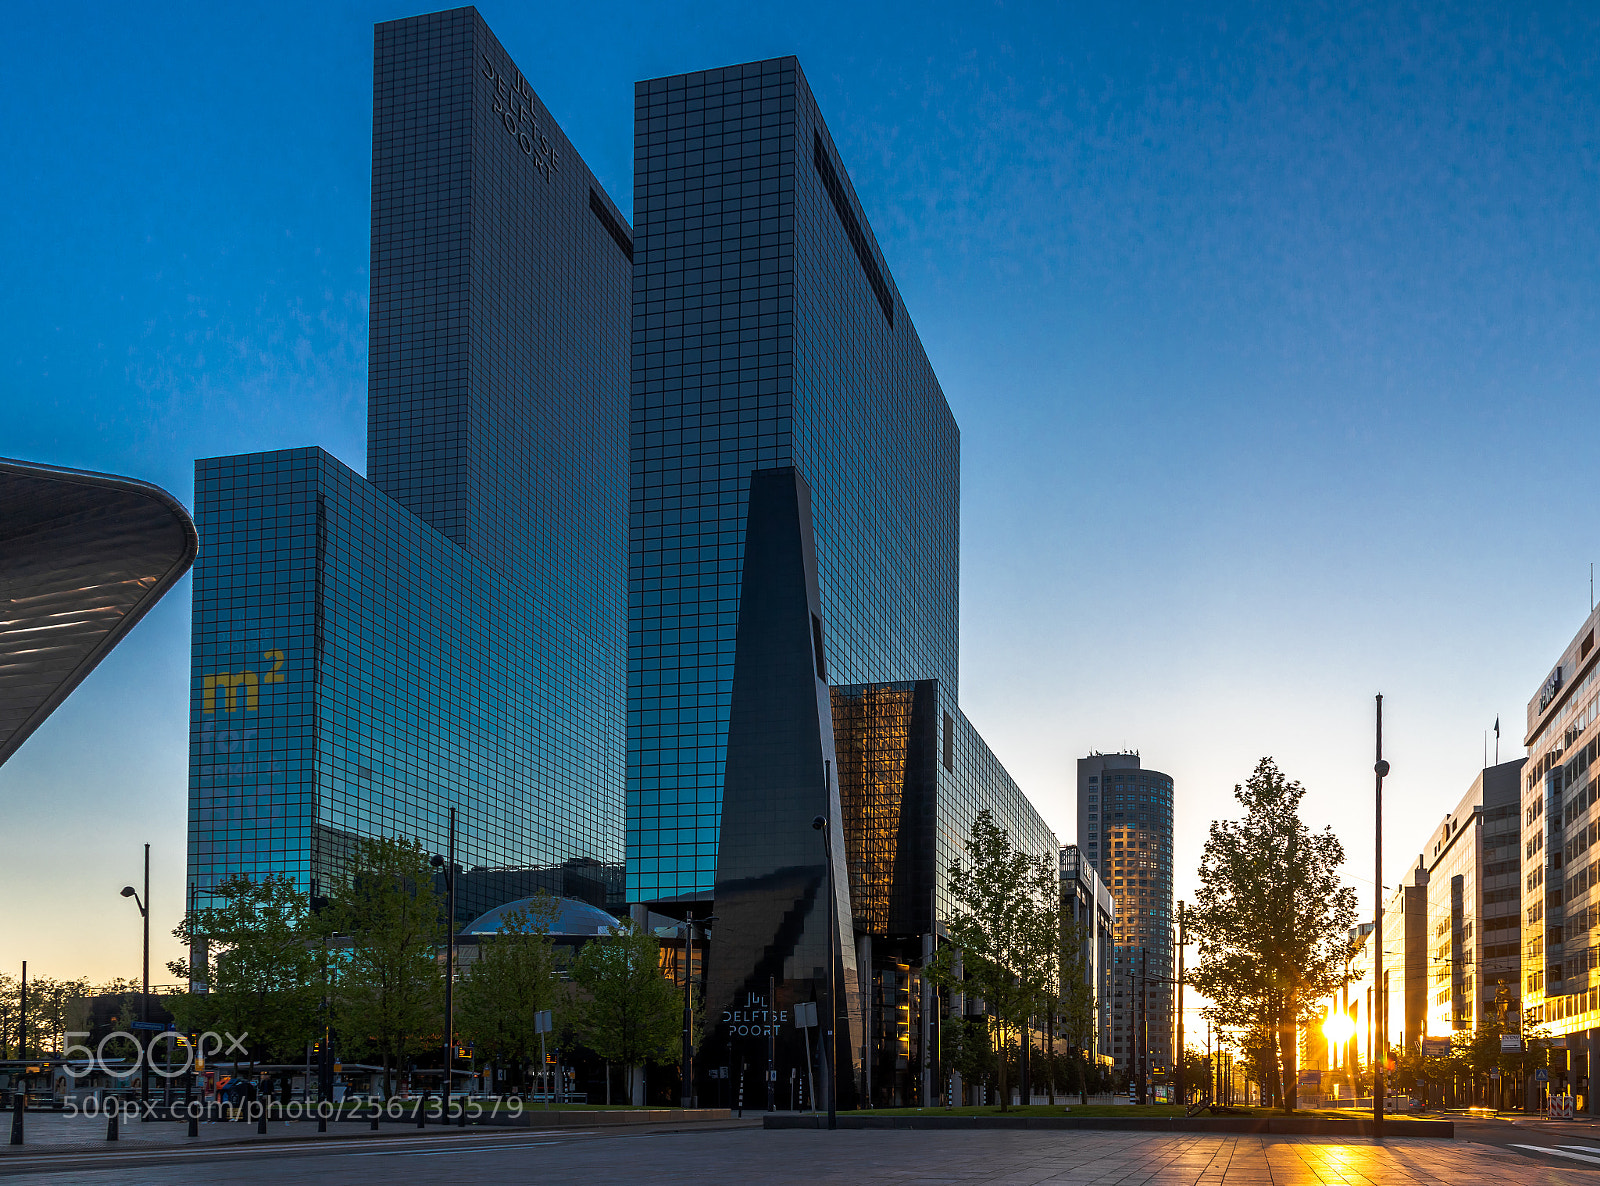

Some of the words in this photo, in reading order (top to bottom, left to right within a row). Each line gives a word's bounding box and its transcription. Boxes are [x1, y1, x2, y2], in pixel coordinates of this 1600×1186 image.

[482, 55, 560, 173] DELFTSE
[492, 94, 553, 184] POORT
[722, 1010, 788, 1022] DELFTSE
[729, 1025, 781, 1036] POORT
